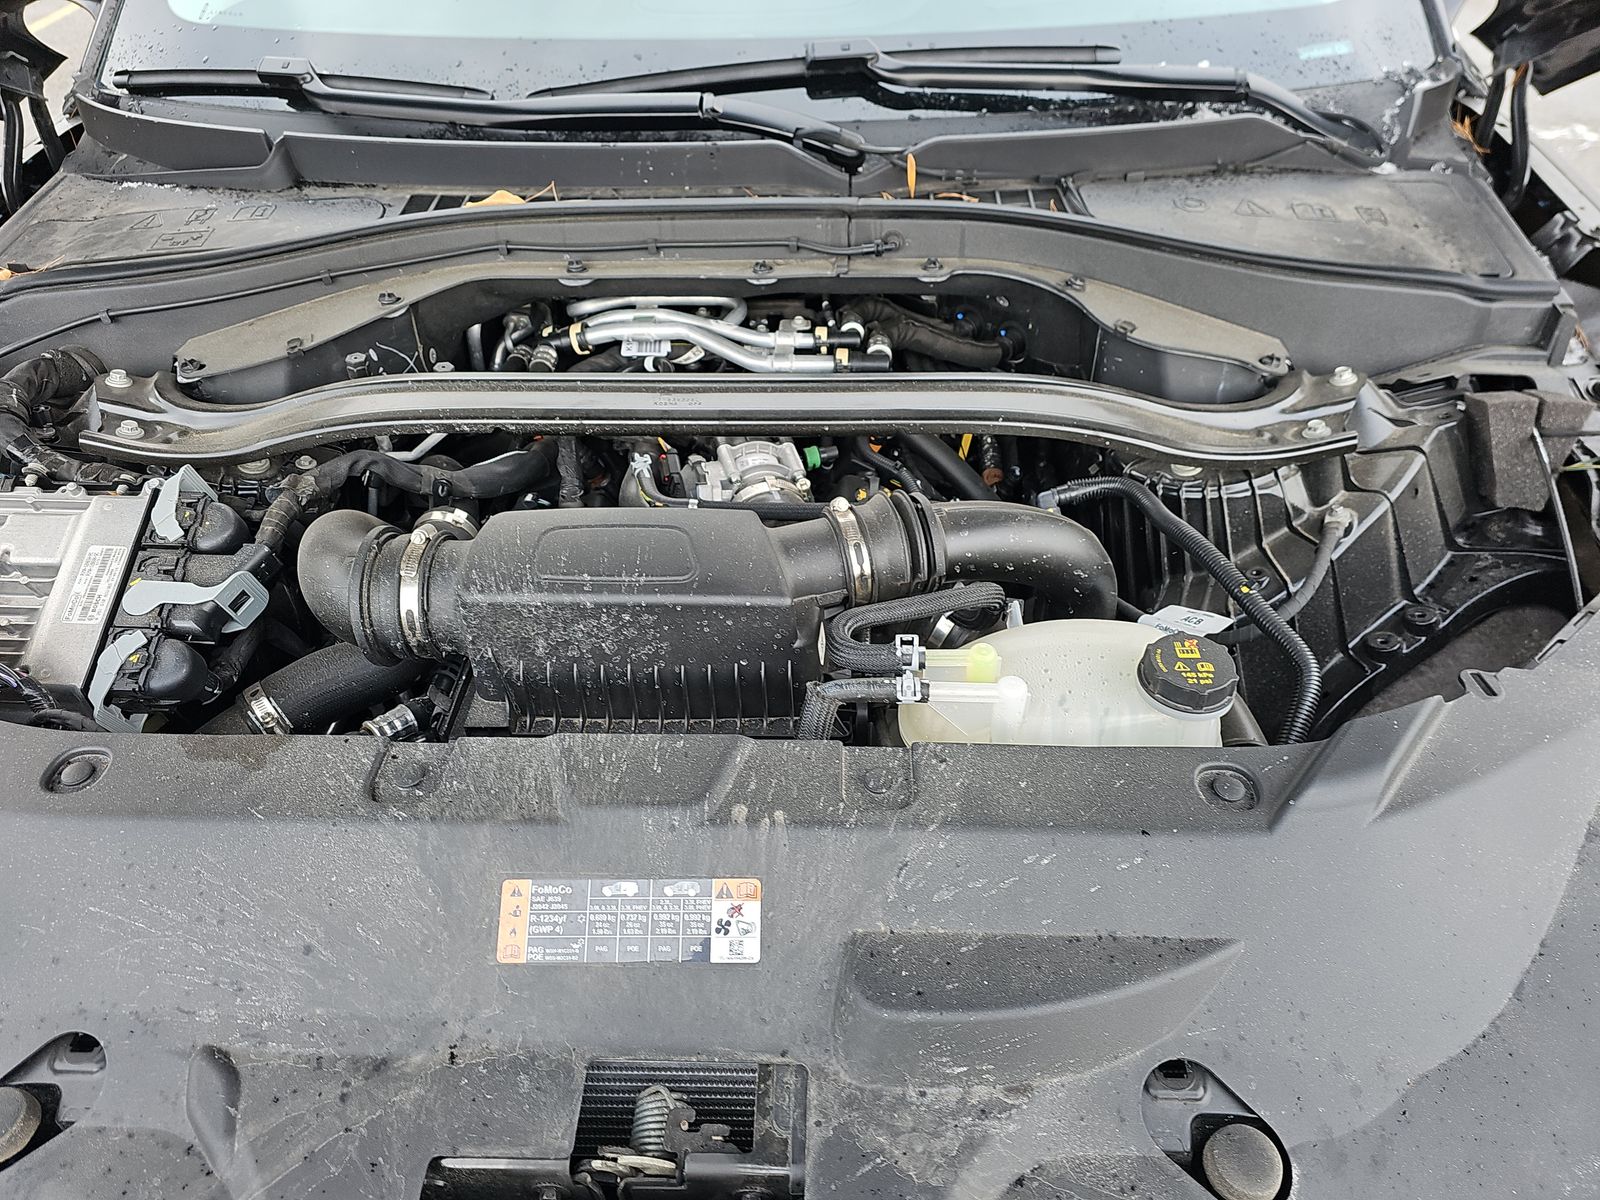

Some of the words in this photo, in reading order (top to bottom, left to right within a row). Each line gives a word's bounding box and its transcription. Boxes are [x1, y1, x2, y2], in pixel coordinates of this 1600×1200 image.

[65, 595, 80, 620] FoMoCo
[91, 594, 102, 612] BOSCH
[1180, 616, 1204, 626] ACB
[1155, 623, 1179, 635] FoMoC
[532, 885, 572, 894] FoMoCo
[530, 914, 567, 924] R-1234yf
[608, 914, 616, 922] kg
[638, 914, 647, 922] kg
[671, 914, 679, 922] kg
[702, 914, 710, 922] kg
[530, 925, 553, 935] (GWP
[555, 925, 563, 935] 4)
